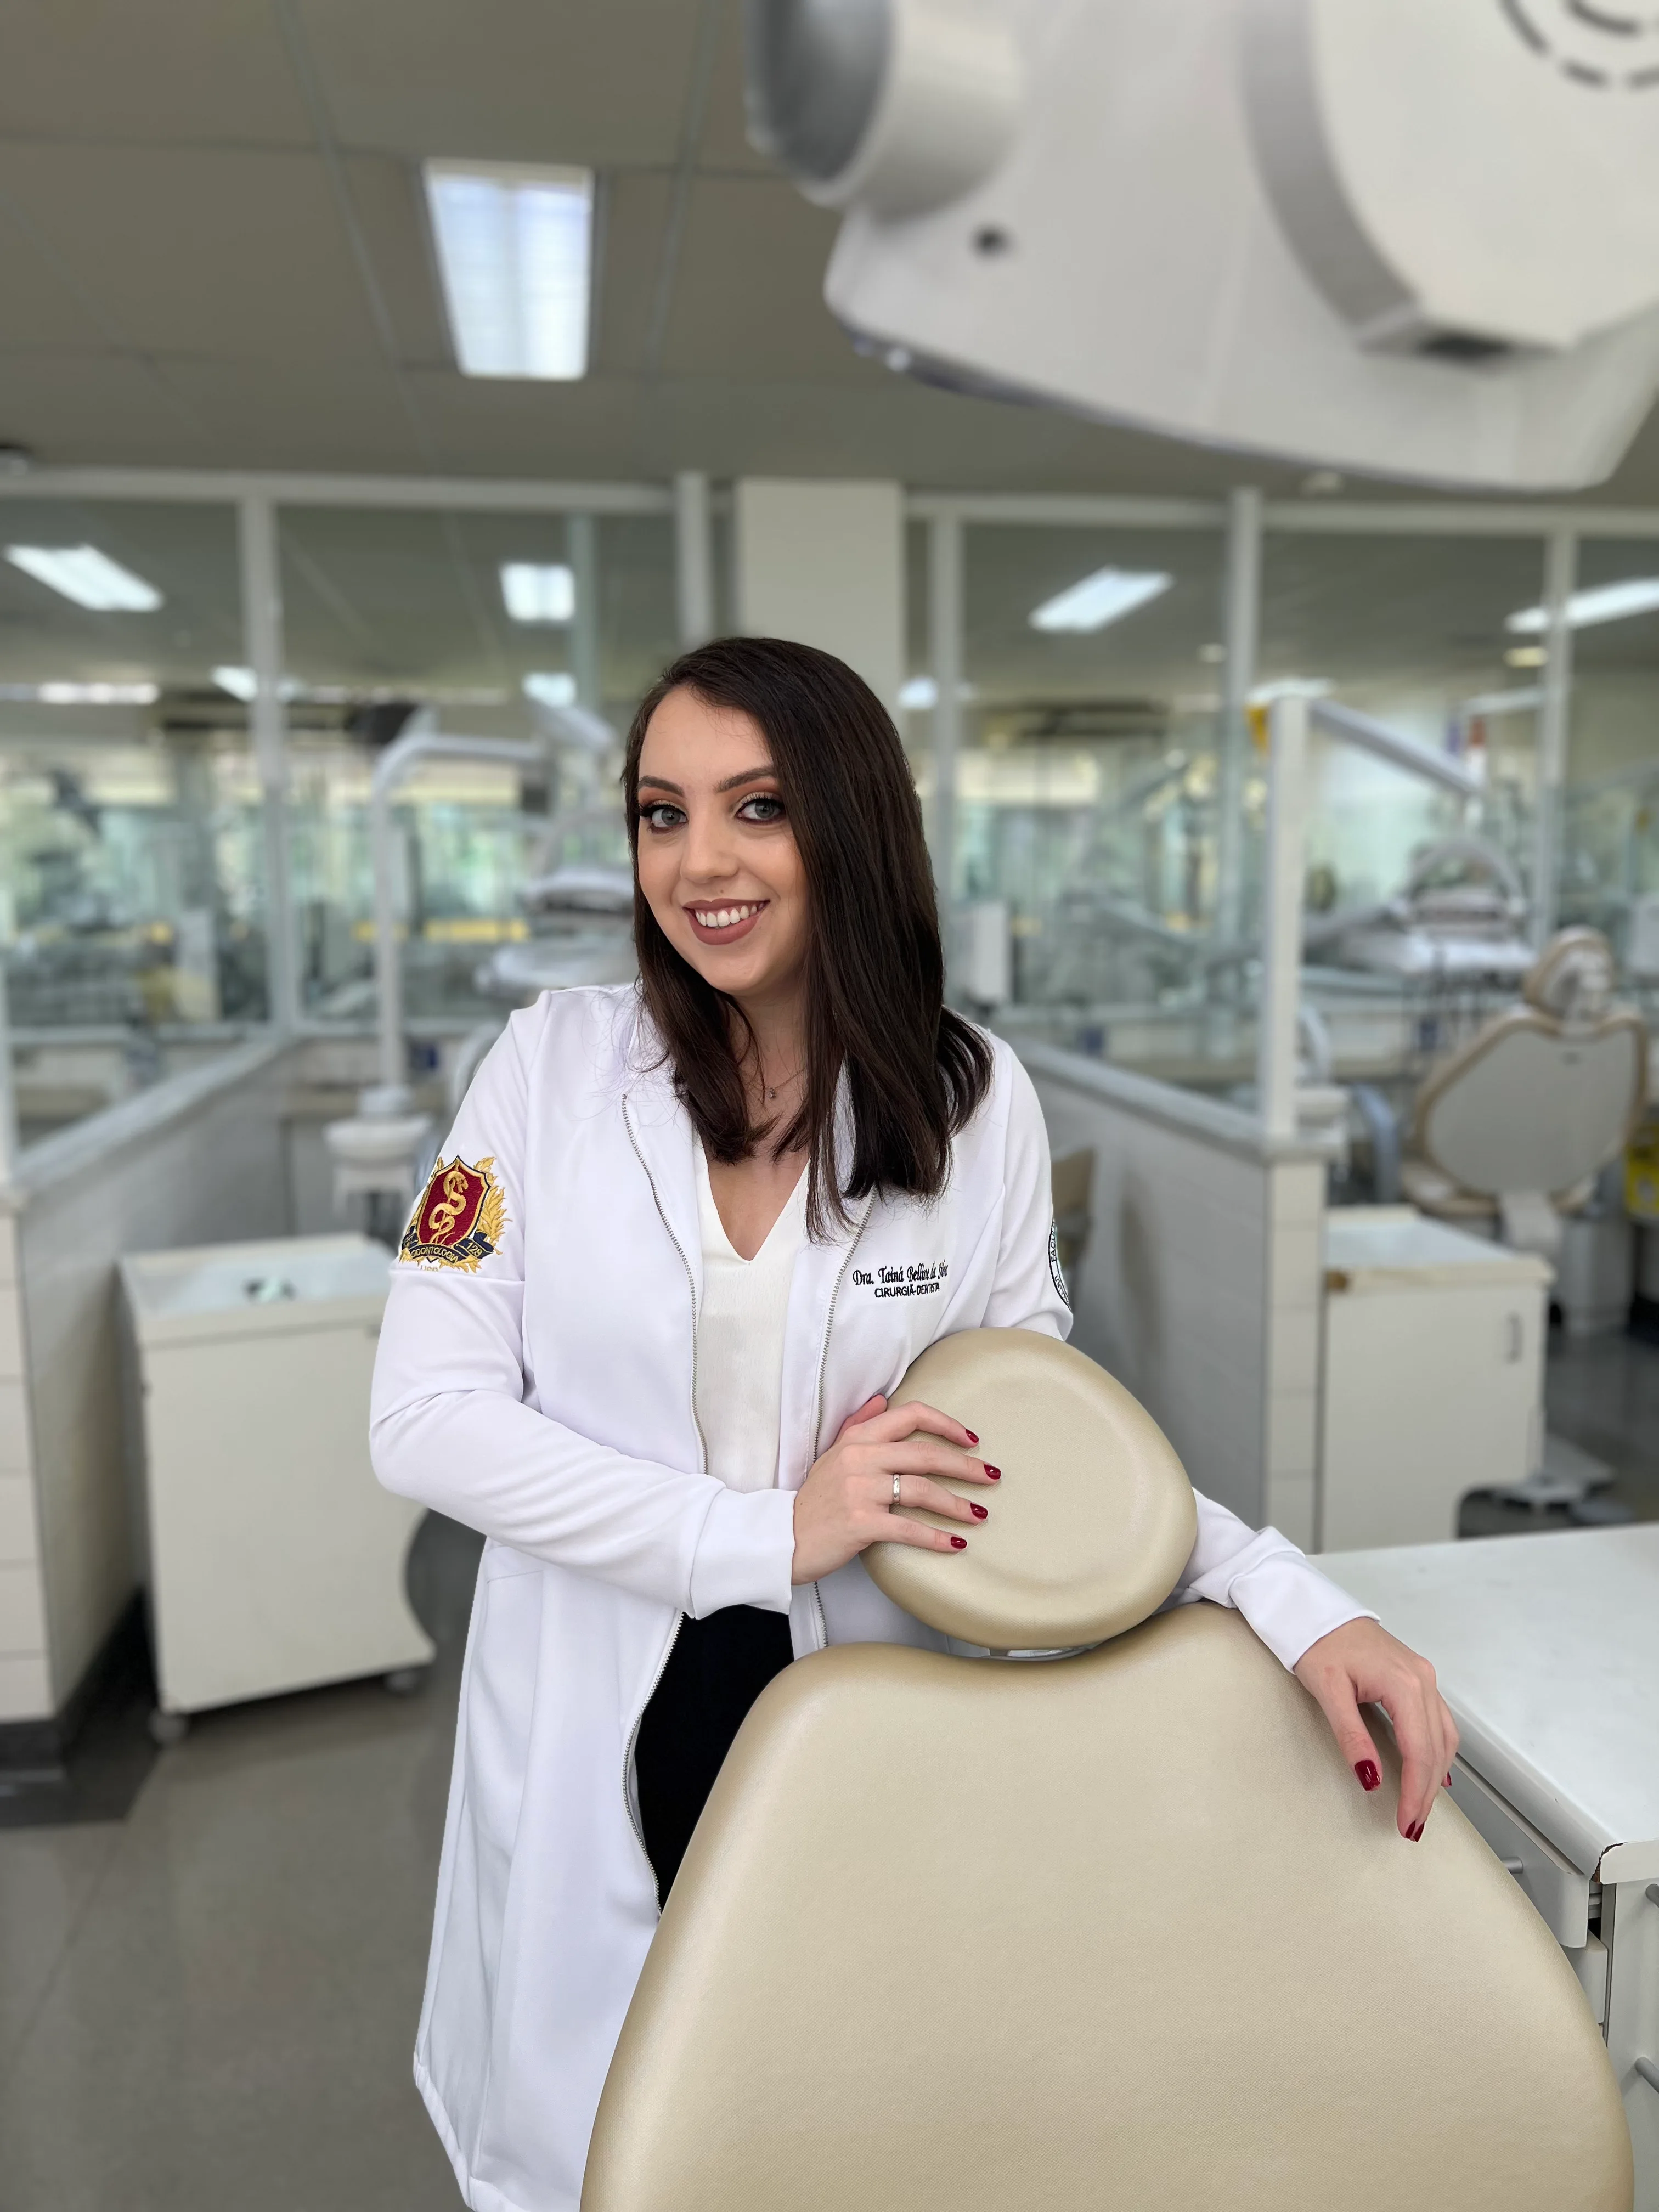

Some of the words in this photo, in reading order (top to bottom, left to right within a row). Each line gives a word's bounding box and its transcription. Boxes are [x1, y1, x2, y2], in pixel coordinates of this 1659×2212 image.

[411, 1246, 459, 1264] ODONTOLOGIA
[466, 1242, 483, 1257] 128
[853, 1269, 874, 1285] Dra.
[874, 1282, 940, 1298] CIRURGIÃ-DENTISTA
